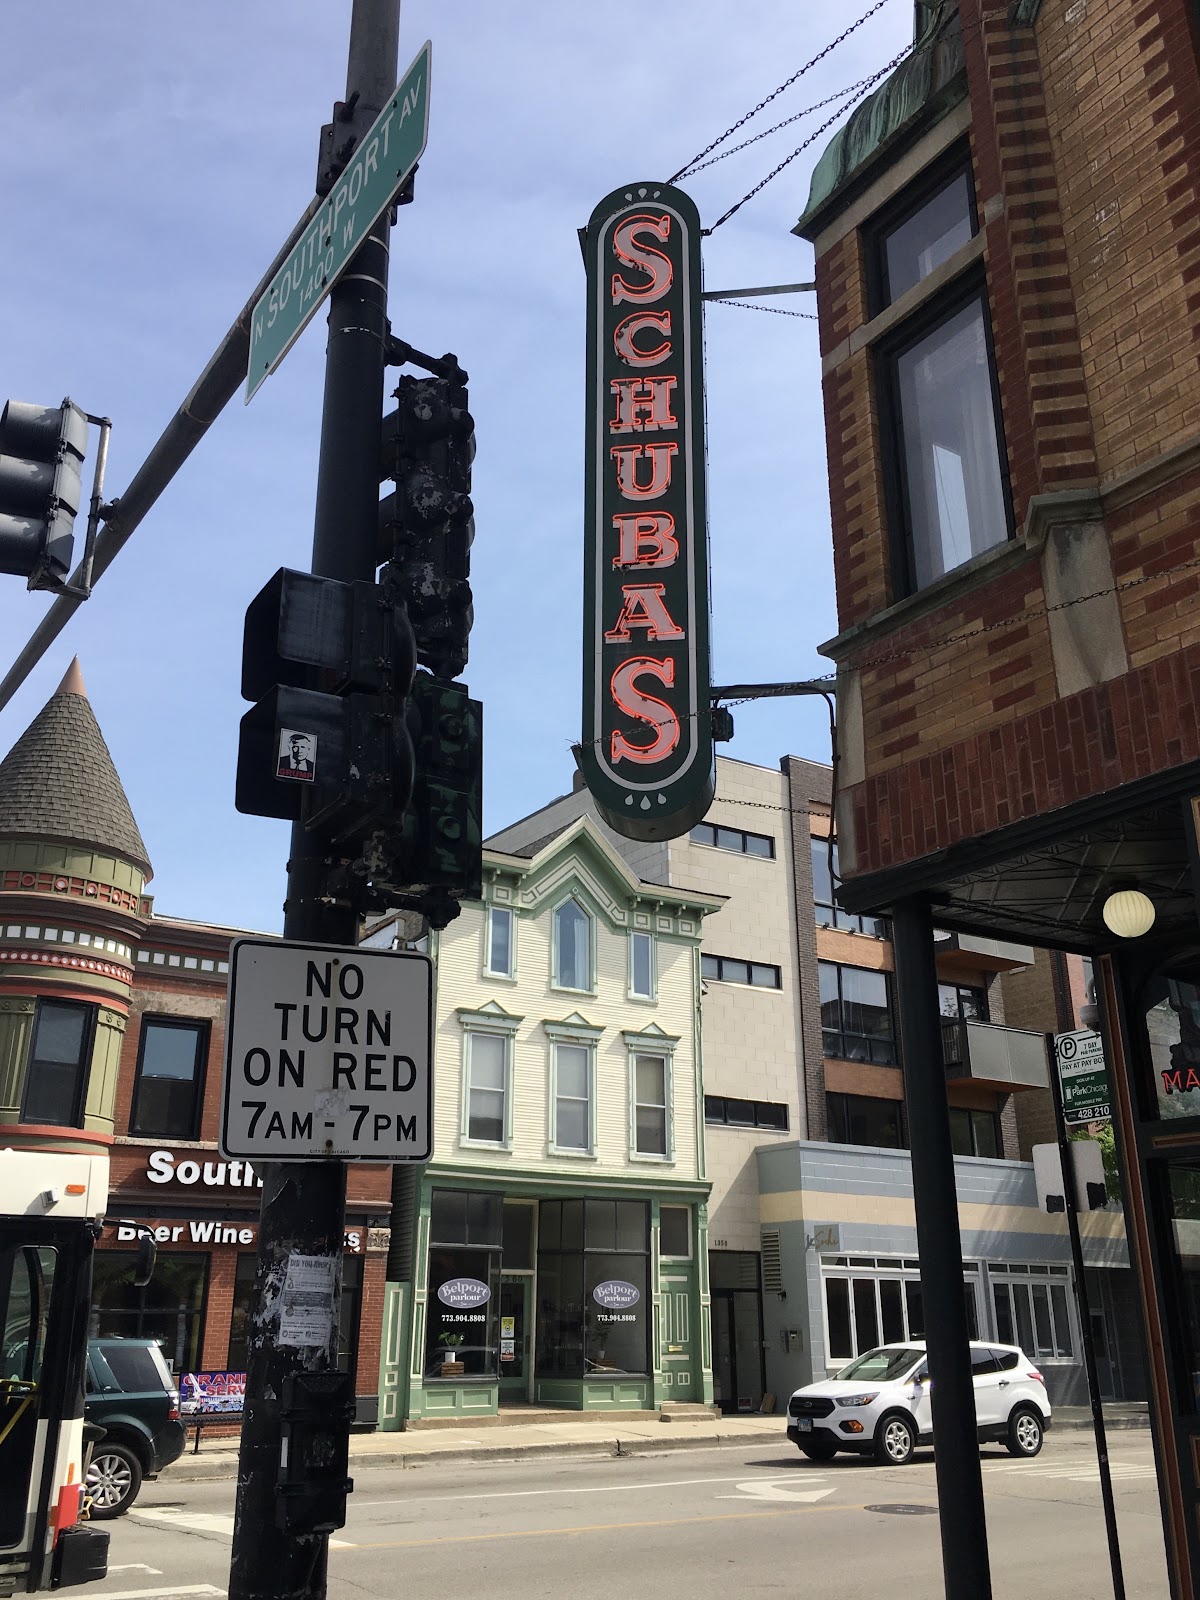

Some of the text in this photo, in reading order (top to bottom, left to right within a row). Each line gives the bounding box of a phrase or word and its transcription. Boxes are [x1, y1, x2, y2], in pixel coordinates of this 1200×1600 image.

[254, 75, 422, 346] N SOUTHPORT AV
[299, 212, 356, 314] 1400 W
[604, 214, 686, 765] SCHUBAS
[306, 960, 364, 1000] NO
[274, 1003, 391, 1047] TURN
[243, 1047, 417, 1092] ON RED
[1061, 1063, 1073, 1071] PAY
[1073, 1061, 1081, 1069] AT
[1081, 1059, 1093, 1068] PAY
[1072, 1084, 1108, 1096] ParkChicag
[1077, 1109, 1093, 1119] 428
[1094, 1105, 1110, 1116] 210
[241, 1101, 313, 1140] 7AM
[349, 1105, 417, 1142] 7PM
[190, 1221, 254, 1244] Wine
[441, 1282, 488, 1298] Belport
[596, 1284, 638, 1299] Belport
[450, 1294, 482, 1303] parlour
[604, 1295, 632, 1303] parlour
[441, 1314, 486, 1322] 773.904.8808
[596, 1314, 637, 1322] 773.904.8808
